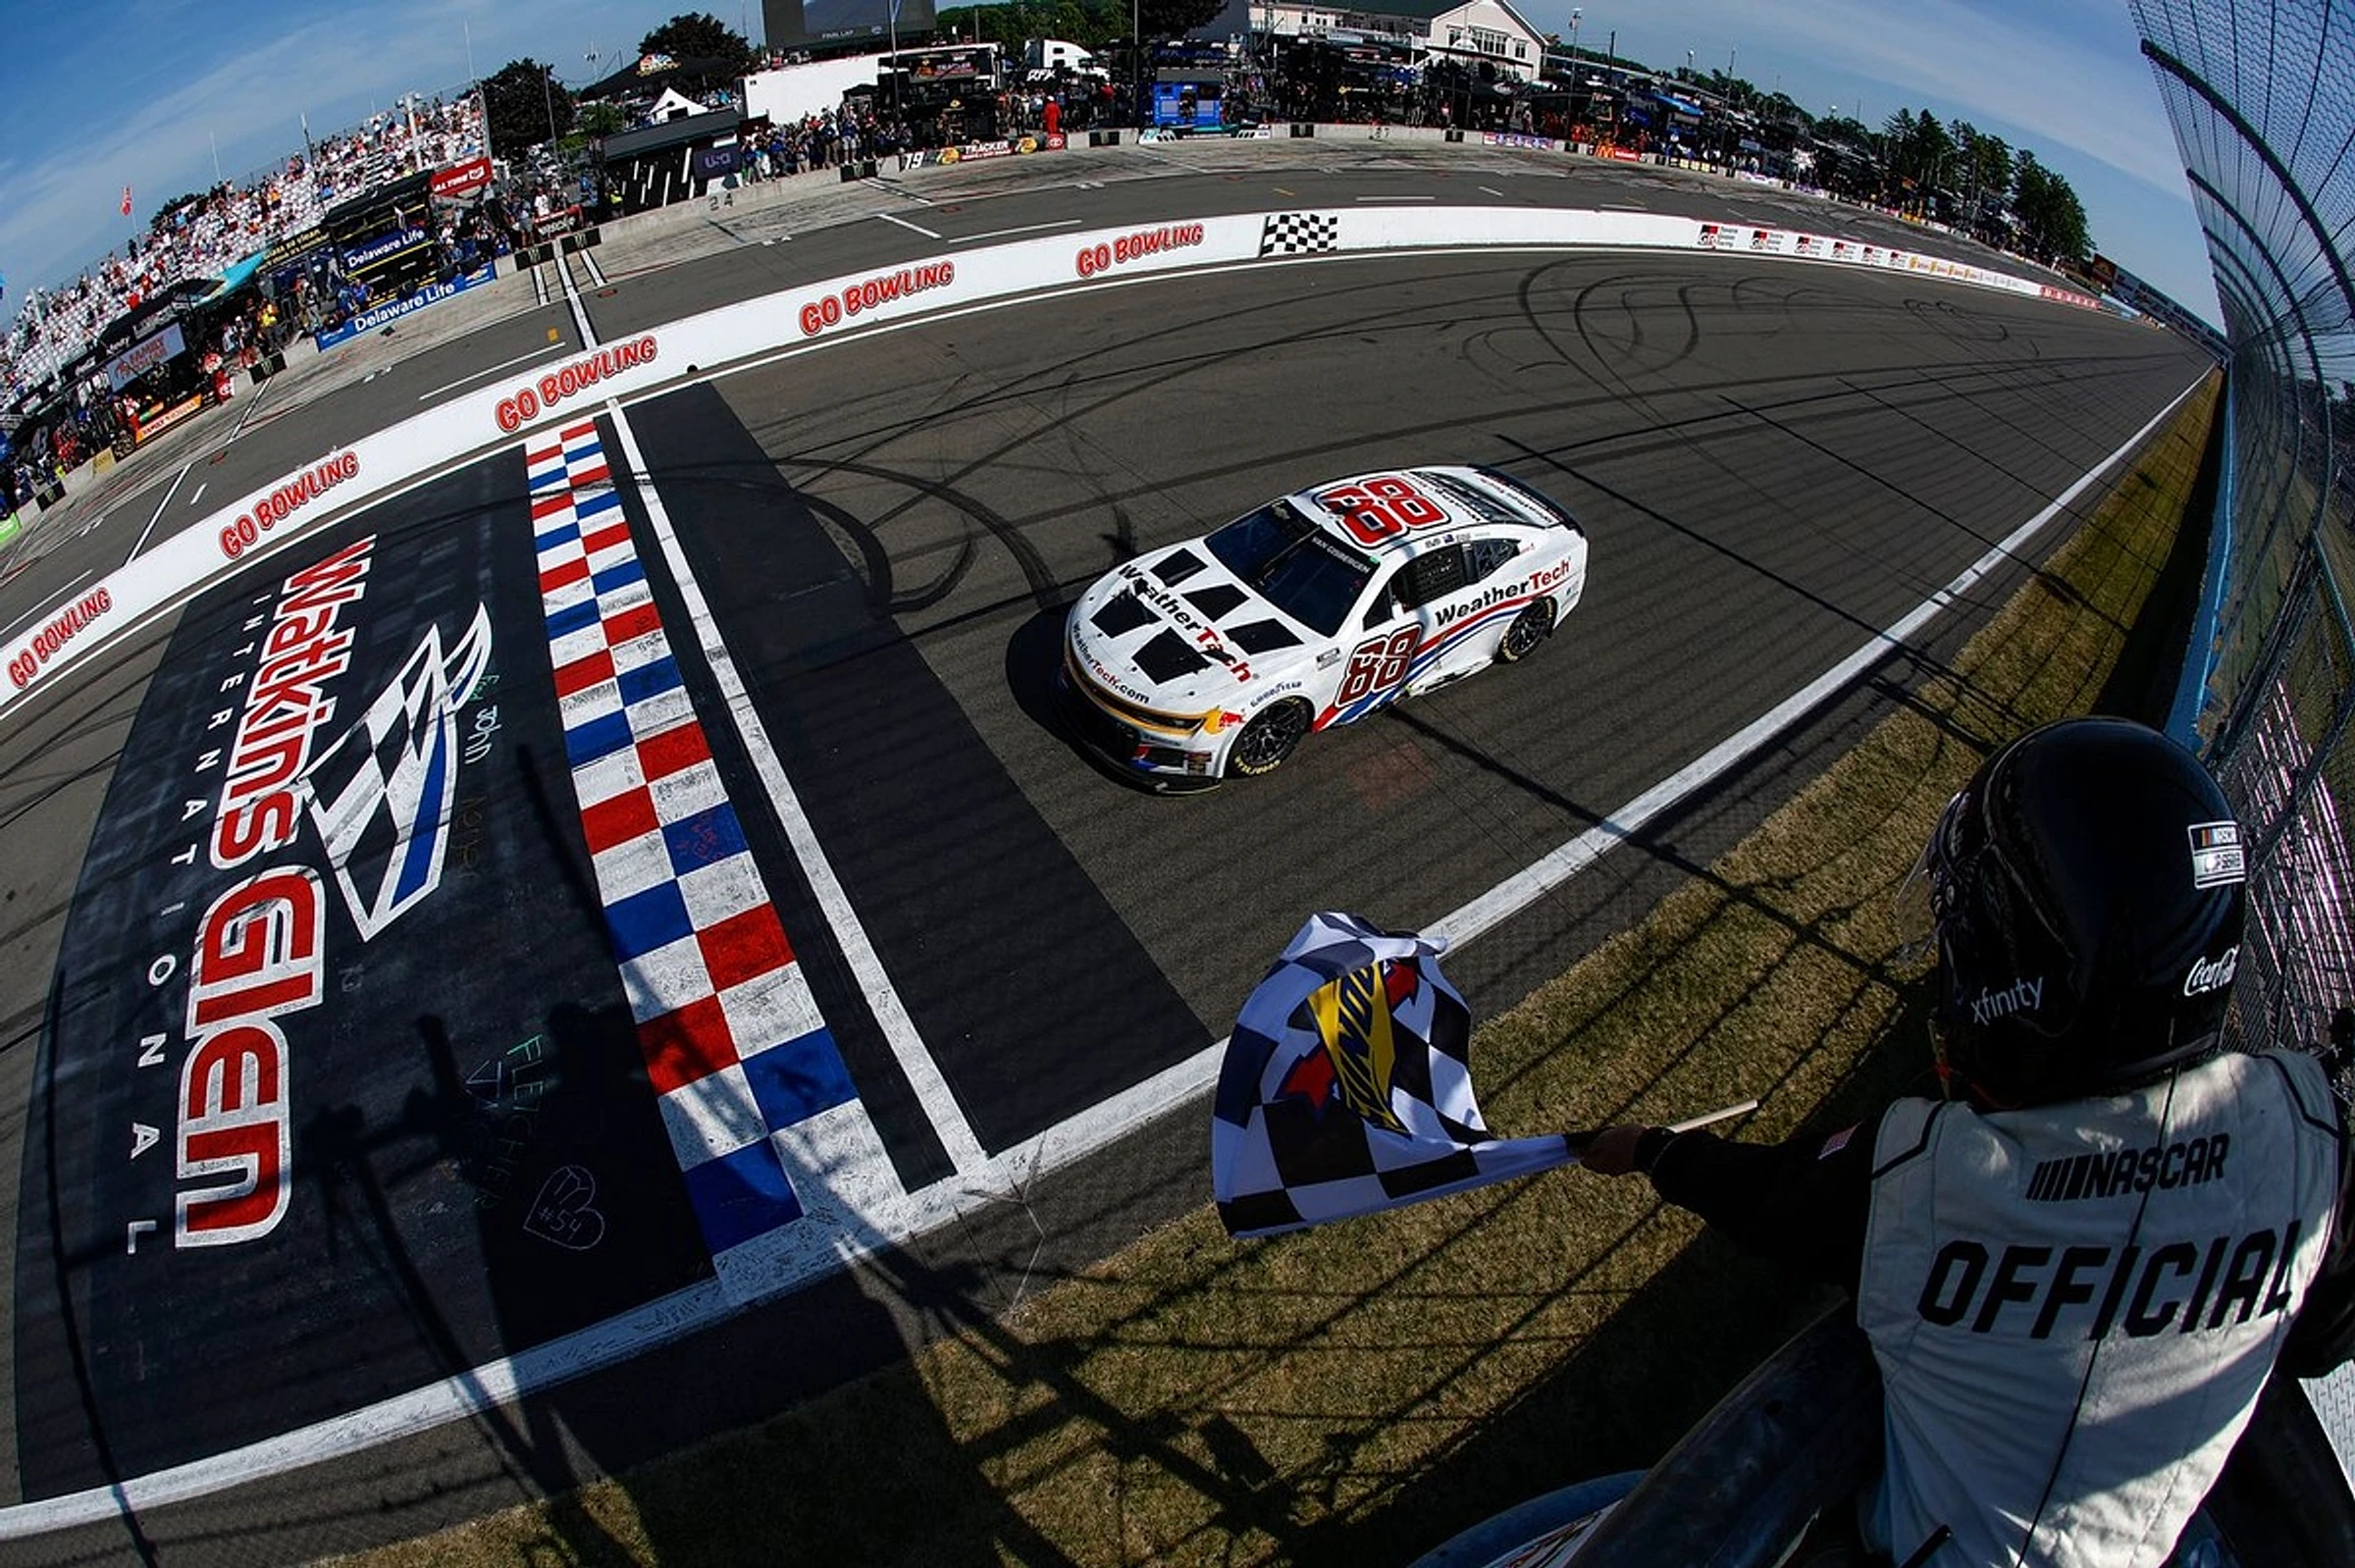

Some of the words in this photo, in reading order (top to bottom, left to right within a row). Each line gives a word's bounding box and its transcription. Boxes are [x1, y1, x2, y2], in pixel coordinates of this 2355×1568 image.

[709, 192, 734, 211] 24
[347, 236, 401, 268] Delaware
[401, 228, 426, 246] Life
[1076, 244, 1112, 277] GO
[1114, 224, 1204, 262] BOWLING
[353, 294, 425, 332] Delaware
[425, 282, 456, 303] Life
[799, 296, 842, 336] GO
[844, 261, 954, 314] BOWLING
[496, 390, 539, 432] GO
[540, 336, 657, 405] BOWLING
[219, 516, 257, 559] GO
[253, 451, 358, 530] BOWLING
[1313, 476, 1450, 548] 88
[1119, 564, 1252, 683] WatherTech
[1436, 559, 1570, 627] WeatherTech
[7, 650, 37, 689] GO
[31, 587, 112, 662] BOWLING
[1335, 624, 1422, 706] 88
[209, 534, 378, 870] Watkins
[127, 593, 273, 1256] INTERNATIONAL
[1969, 975, 2044, 1027] xfinity
[175, 865, 326, 1248] Glen
[2081, 1131, 2231, 1200] NASCAR
[1916, 1219, 2303, 1341] OFFICIAL
